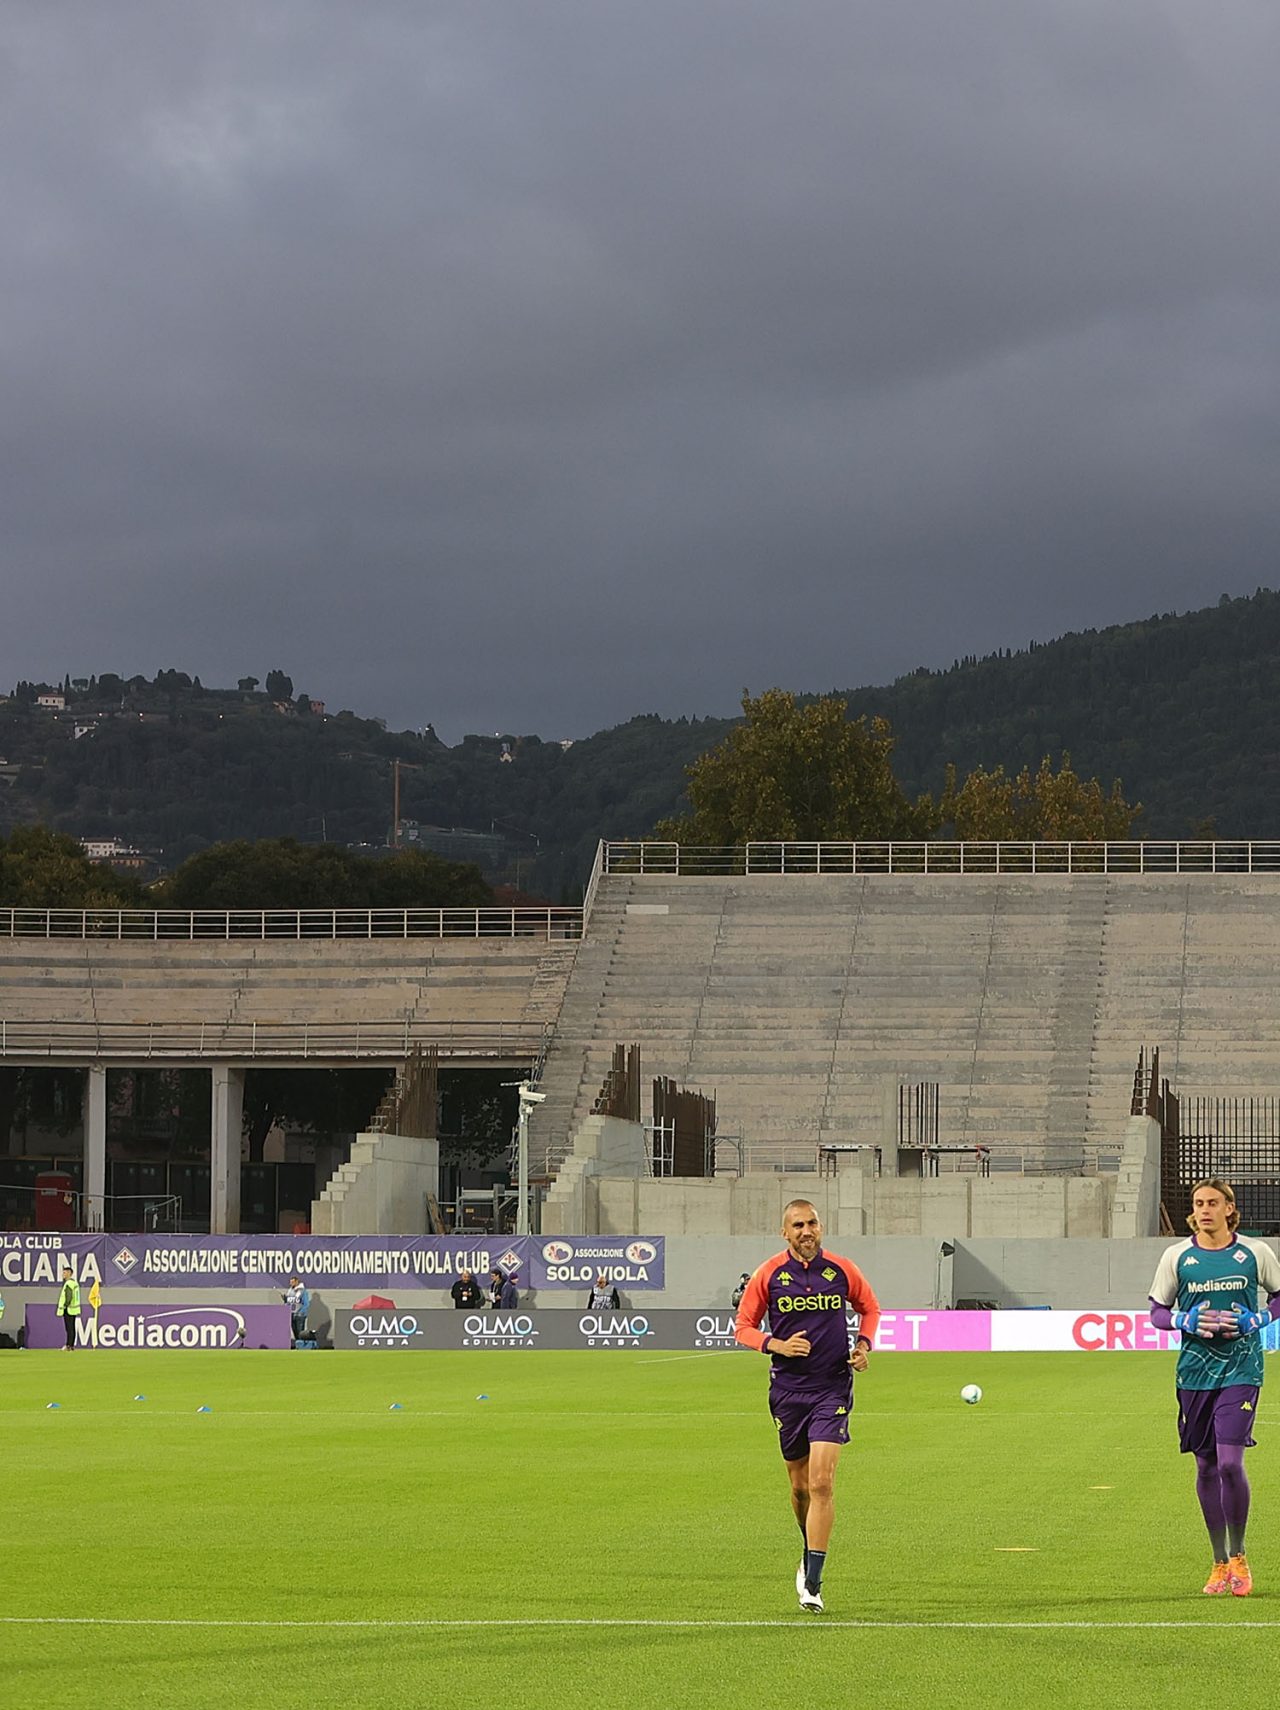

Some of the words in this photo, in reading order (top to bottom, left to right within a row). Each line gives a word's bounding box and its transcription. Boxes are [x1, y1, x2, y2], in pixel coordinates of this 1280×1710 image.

[0, 1237, 22, 1249] LA
[26, 1237, 62, 1249] CLUB
[574, 1248, 624, 1258] ASSOCIAZIONE
[0, 1252, 102, 1282] CIANA
[143, 1249, 238, 1273] ASSOCIAZIONE
[241, 1250, 293, 1273] CENTRO
[296, 1251, 409, 1275] COORDINAMENTO
[412, 1252, 453, 1274] VIOLA
[455, 1252, 490, 1273] CLUB
[546, 1266, 593, 1281] SOLO
[597, 1266, 648, 1281] VIOLA
[1188, 1280, 1243, 1293] Mediacom
[793, 1292, 841, 1311] estra
[74, 1316, 228, 1348] Mediacom
[350, 1315, 418, 1335] OLMO
[464, 1315, 533, 1335] OLMO
[579, 1315, 648, 1335] OLMO
